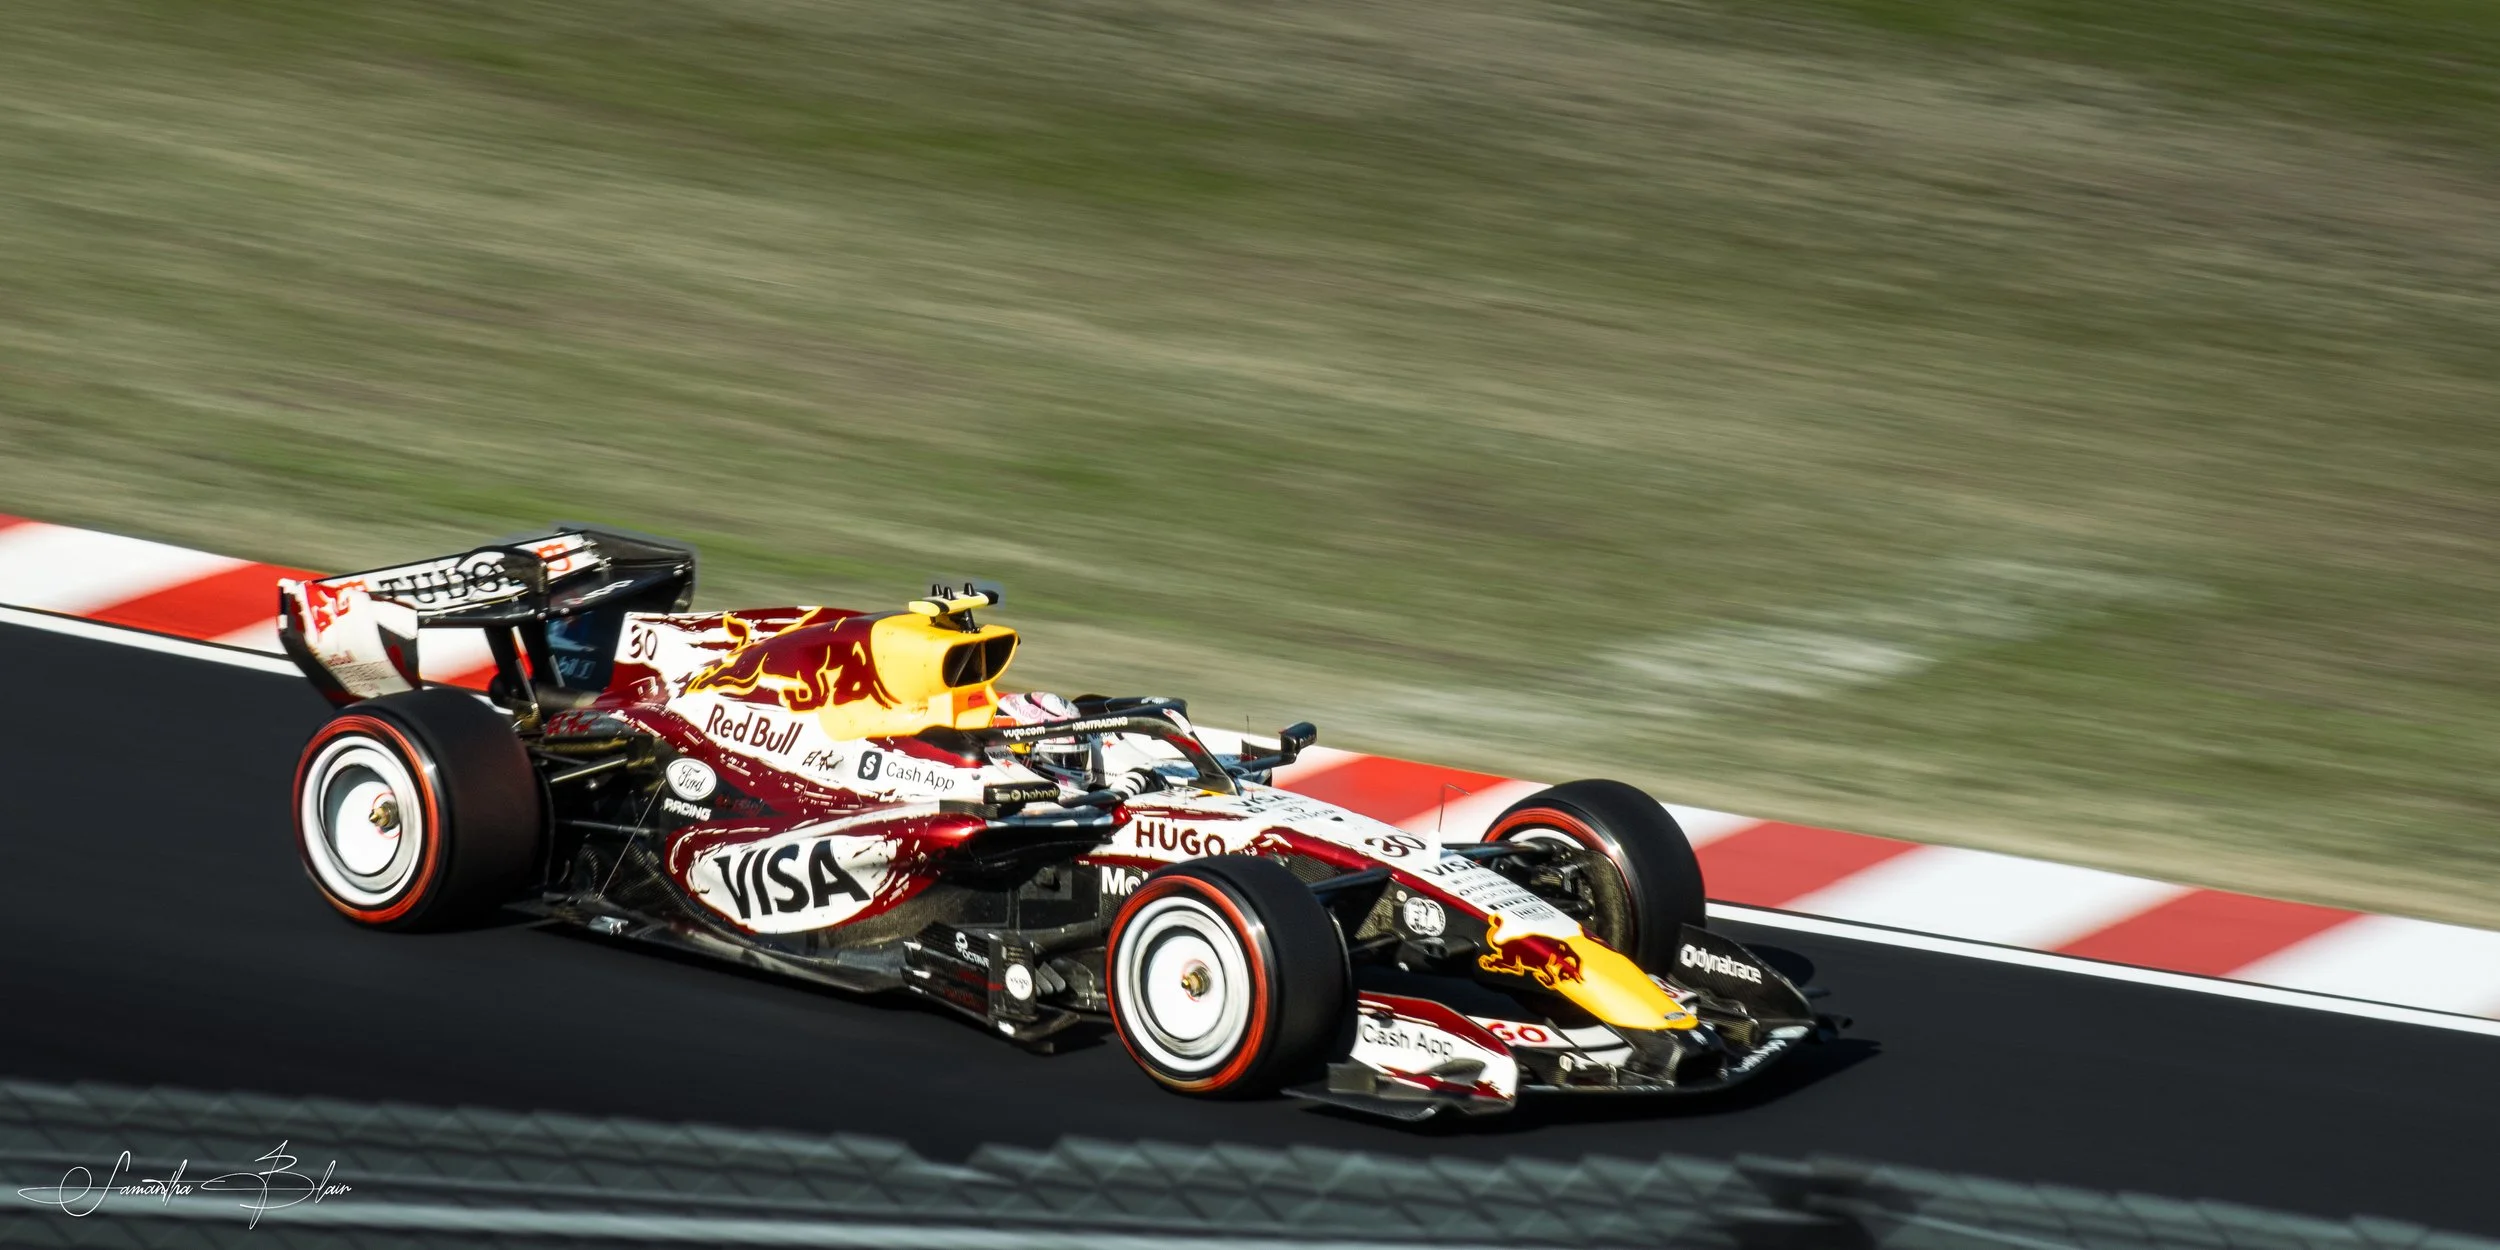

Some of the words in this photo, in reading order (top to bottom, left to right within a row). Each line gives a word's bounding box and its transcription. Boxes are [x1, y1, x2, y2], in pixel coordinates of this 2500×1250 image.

[379, 561, 525, 603] TUDO
[629, 624, 658, 661] 30
[706, 703, 753, 743] Red
[749, 716, 804, 756] Bull
[679, 764, 707, 792] Ford
[886, 761, 921, 783] Cash
[923, 770, 955, 792] App
[663, 797, 712, 822] RACING
[1136, 820, 1226, 856] HUGO
[1364, 834, 1427, 858] 30
[714, 839, 872, 919] VISA
[1421, 860, 1480, 876] VISA
[1694, 948, 1762, 985] dynatrace
[1361, 1022, 1411, 1051] Cash
[1415, 1031, 1454, 1062] App
